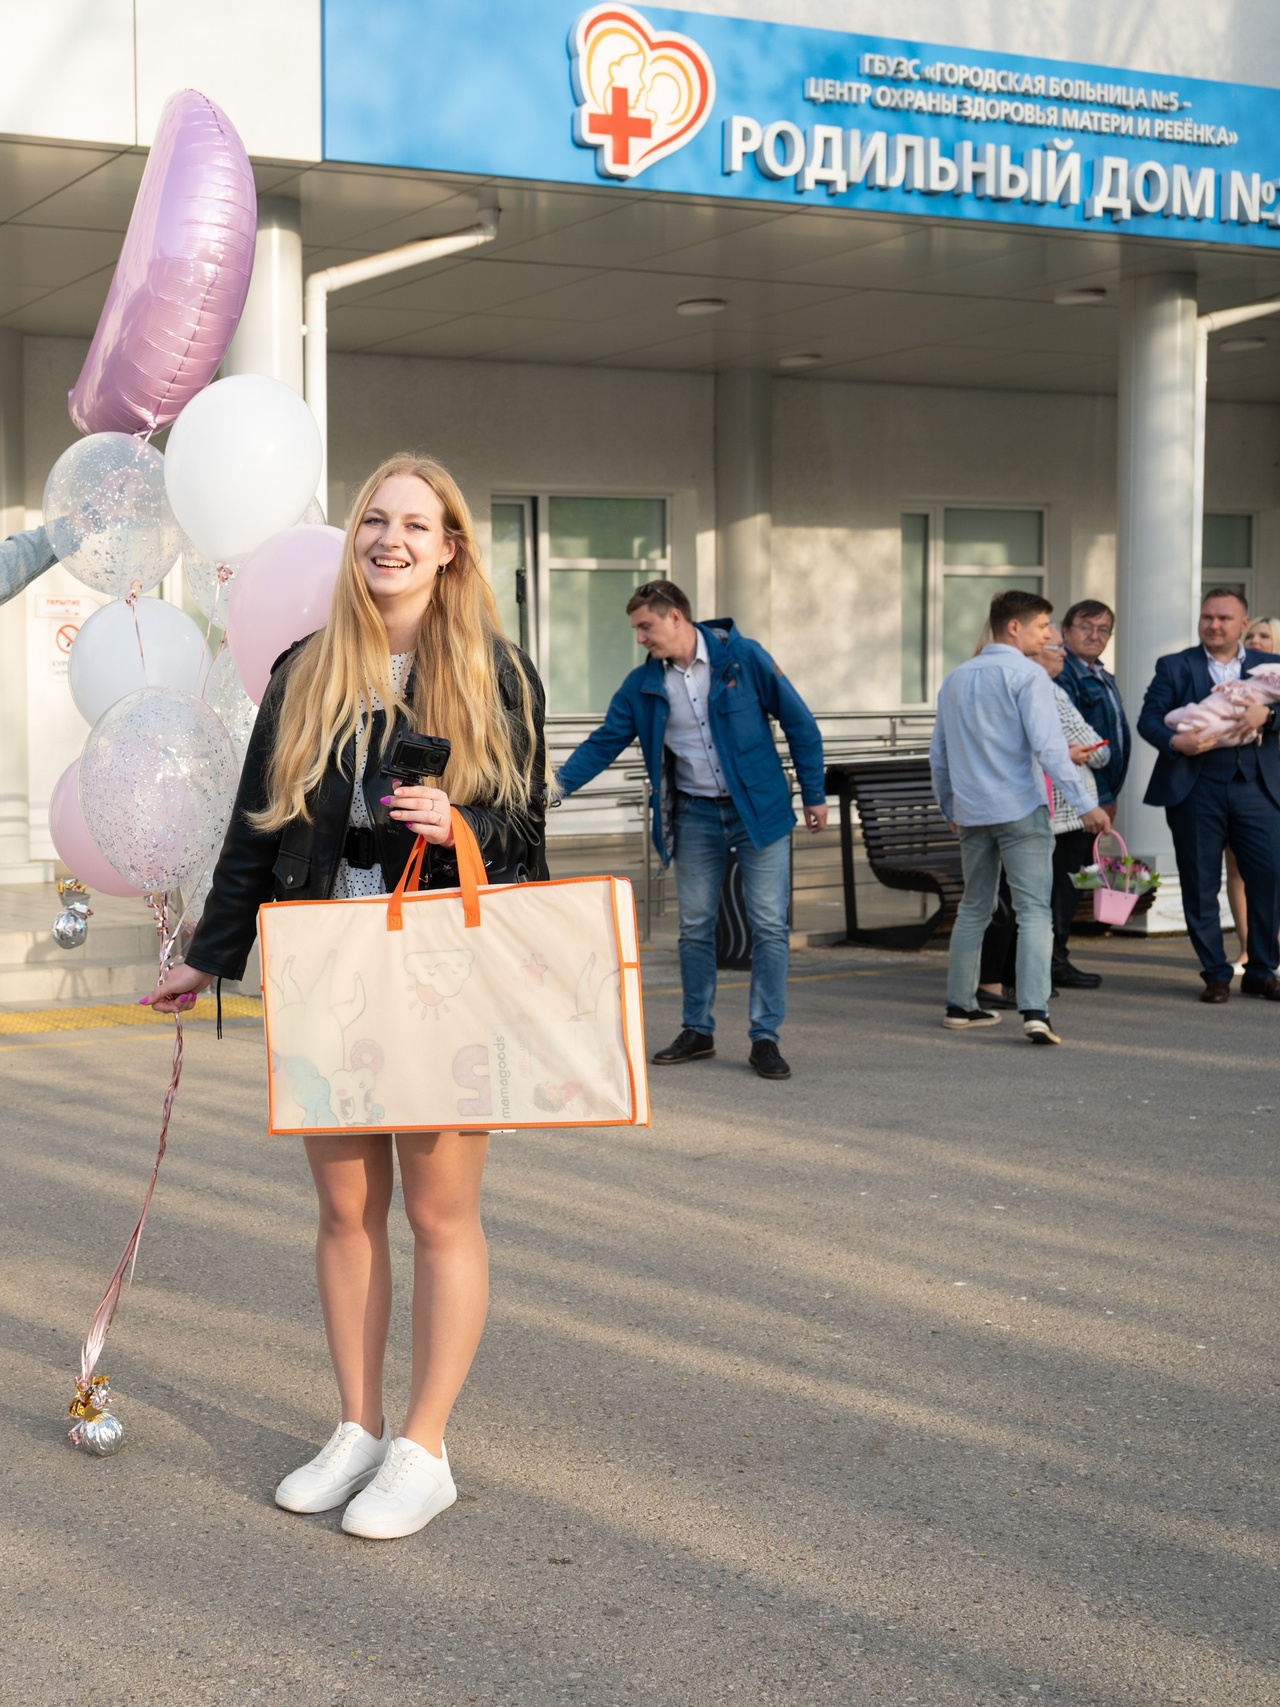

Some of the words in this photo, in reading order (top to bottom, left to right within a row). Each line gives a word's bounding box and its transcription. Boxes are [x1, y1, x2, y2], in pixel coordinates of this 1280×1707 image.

[808, 76, 872, 103] ЦЕНТР
[874, 85, 958, 115] ОХРАНЫ
[961, 95, 1058, 127] ЗДОРОВЬЯ
[1061, 107, 1133, 136] МАТЕРИ
[1137, 116, 1151, 138] И
[1154, 117, 1239, 146] РЕБЁНКА»
[861, 53, 921, 81] ГБУЗС
[924, 61, 1046, 95] «ГОРОДСКАЯ
[1049, 76, 1148, 110] БОЛЬНИЦА
[1151, 89, 1179, 112] №5
[727, 115, 1081, 207] РОДИЛЬНЫЙ
[1091, 156, 1216, 221] ДОМ
[493, 1035, 511, 1119] mamagoods
